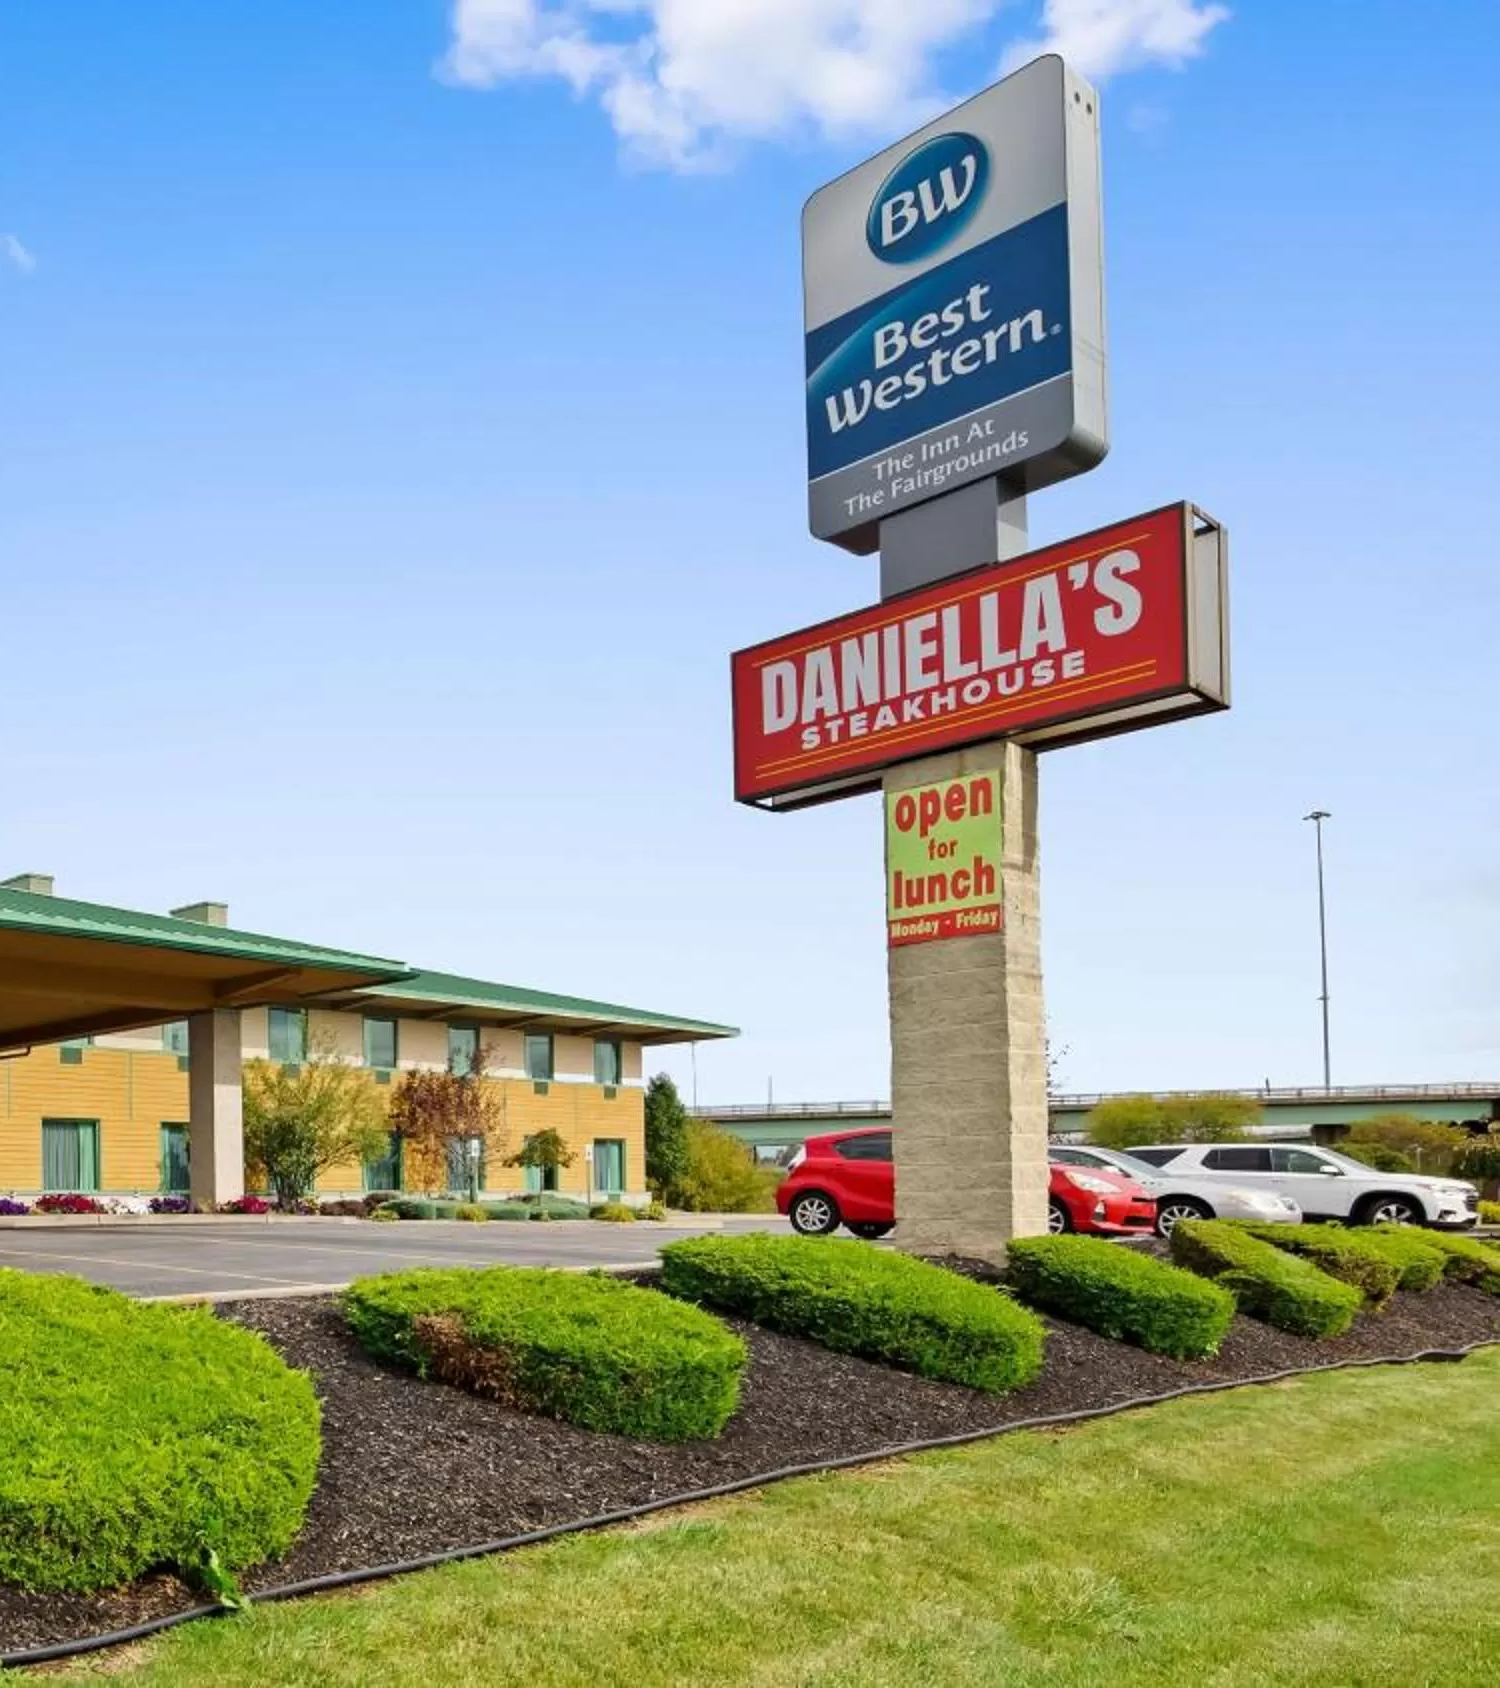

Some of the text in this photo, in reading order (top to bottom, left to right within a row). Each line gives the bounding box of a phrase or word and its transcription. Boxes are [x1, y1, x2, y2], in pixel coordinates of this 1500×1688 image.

[880, 153, 977, 248] BW
[873, 283, 993, 370] Best
[825, 308, 1047, 434] Western
[843, 430, 1029, 517] The Fairgrounds
[871, 418, 995, 481] The Inn At
[761, 548, 1144, 736] DANIELLA'S
[801, 649, 1085, 750] STEAKHOUSE
[894, 776, 992, 839] open
[927, 838, 958, 861] for
[890, 918, 940, 938] Monday
[955, 908, 998, 929] Friday
[893, 856, 995, 909] lunch
